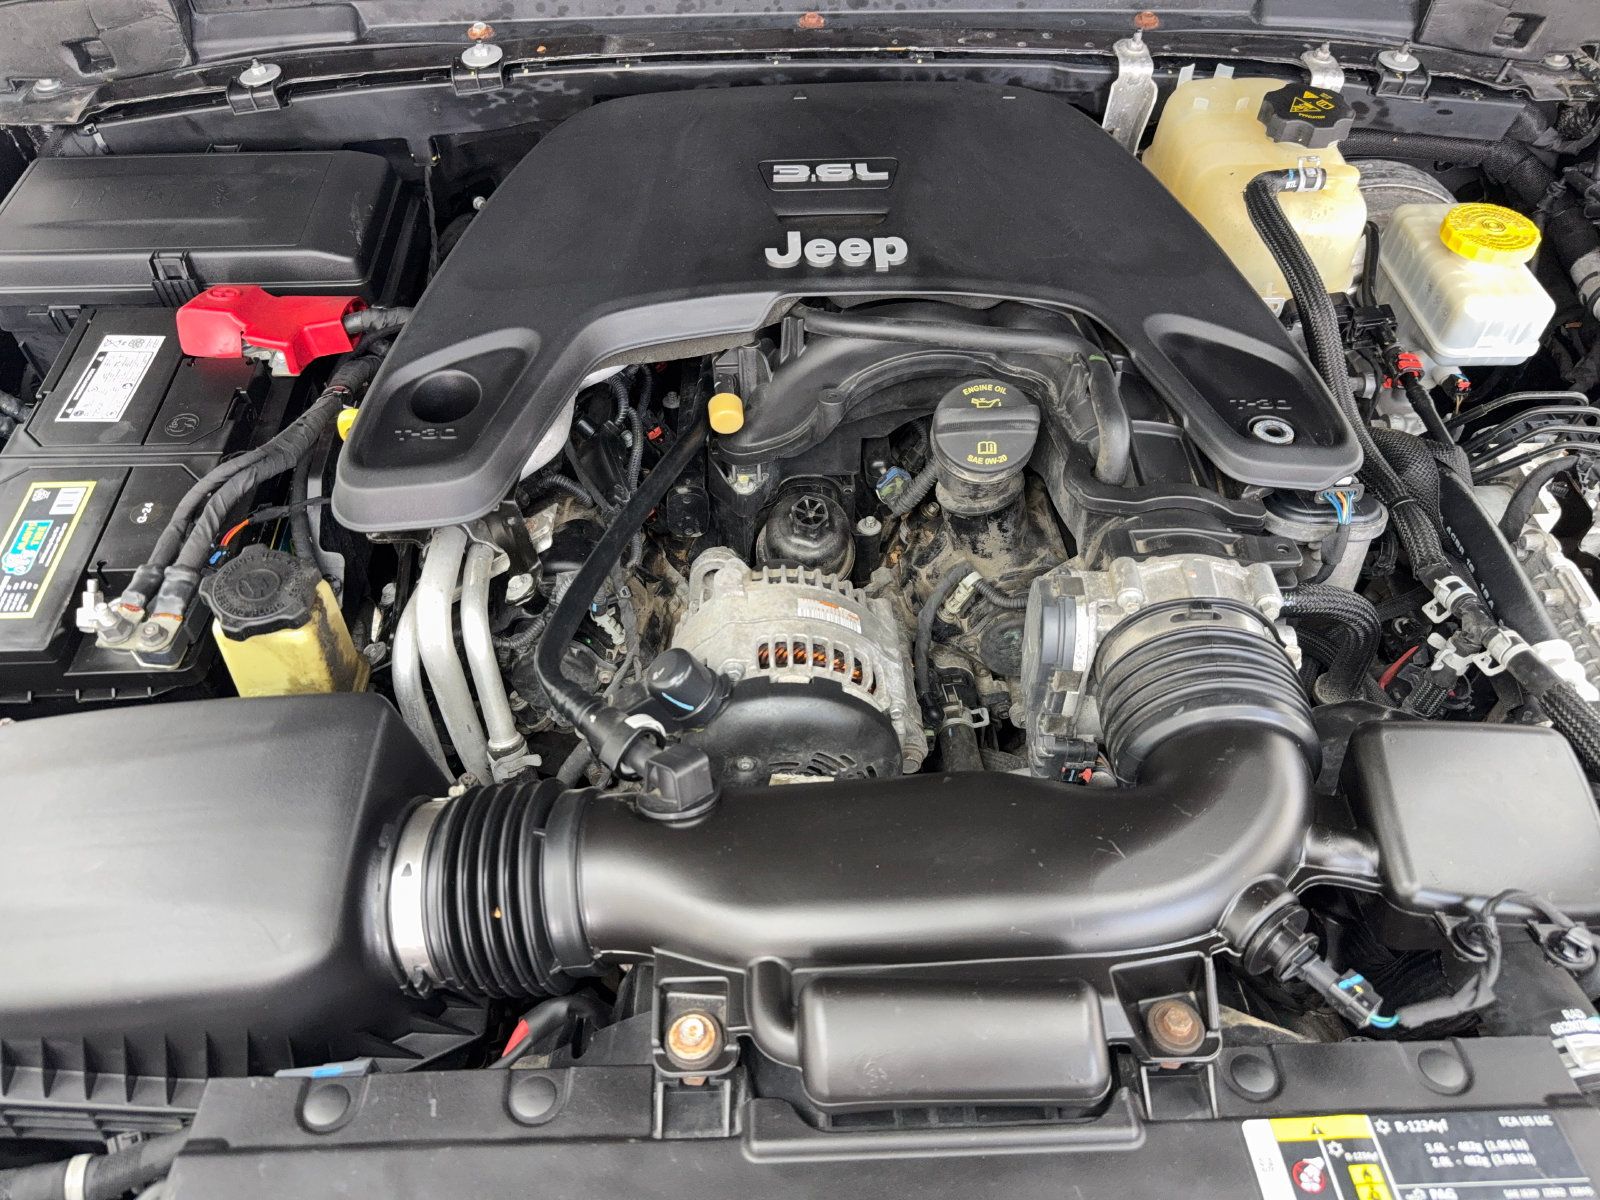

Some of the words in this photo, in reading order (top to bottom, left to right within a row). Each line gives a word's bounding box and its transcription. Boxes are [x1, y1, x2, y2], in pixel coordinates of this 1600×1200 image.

[773, 163, 888, 183] 3.6L
[764, 231, 908, 272] Jeep
[962, 384, 993, 396] ENGINE
[994, 385, 1007, 395] OIL
[966, 454, 984, 465] SAE
[985, 454, 1008, 465] 0W-20
